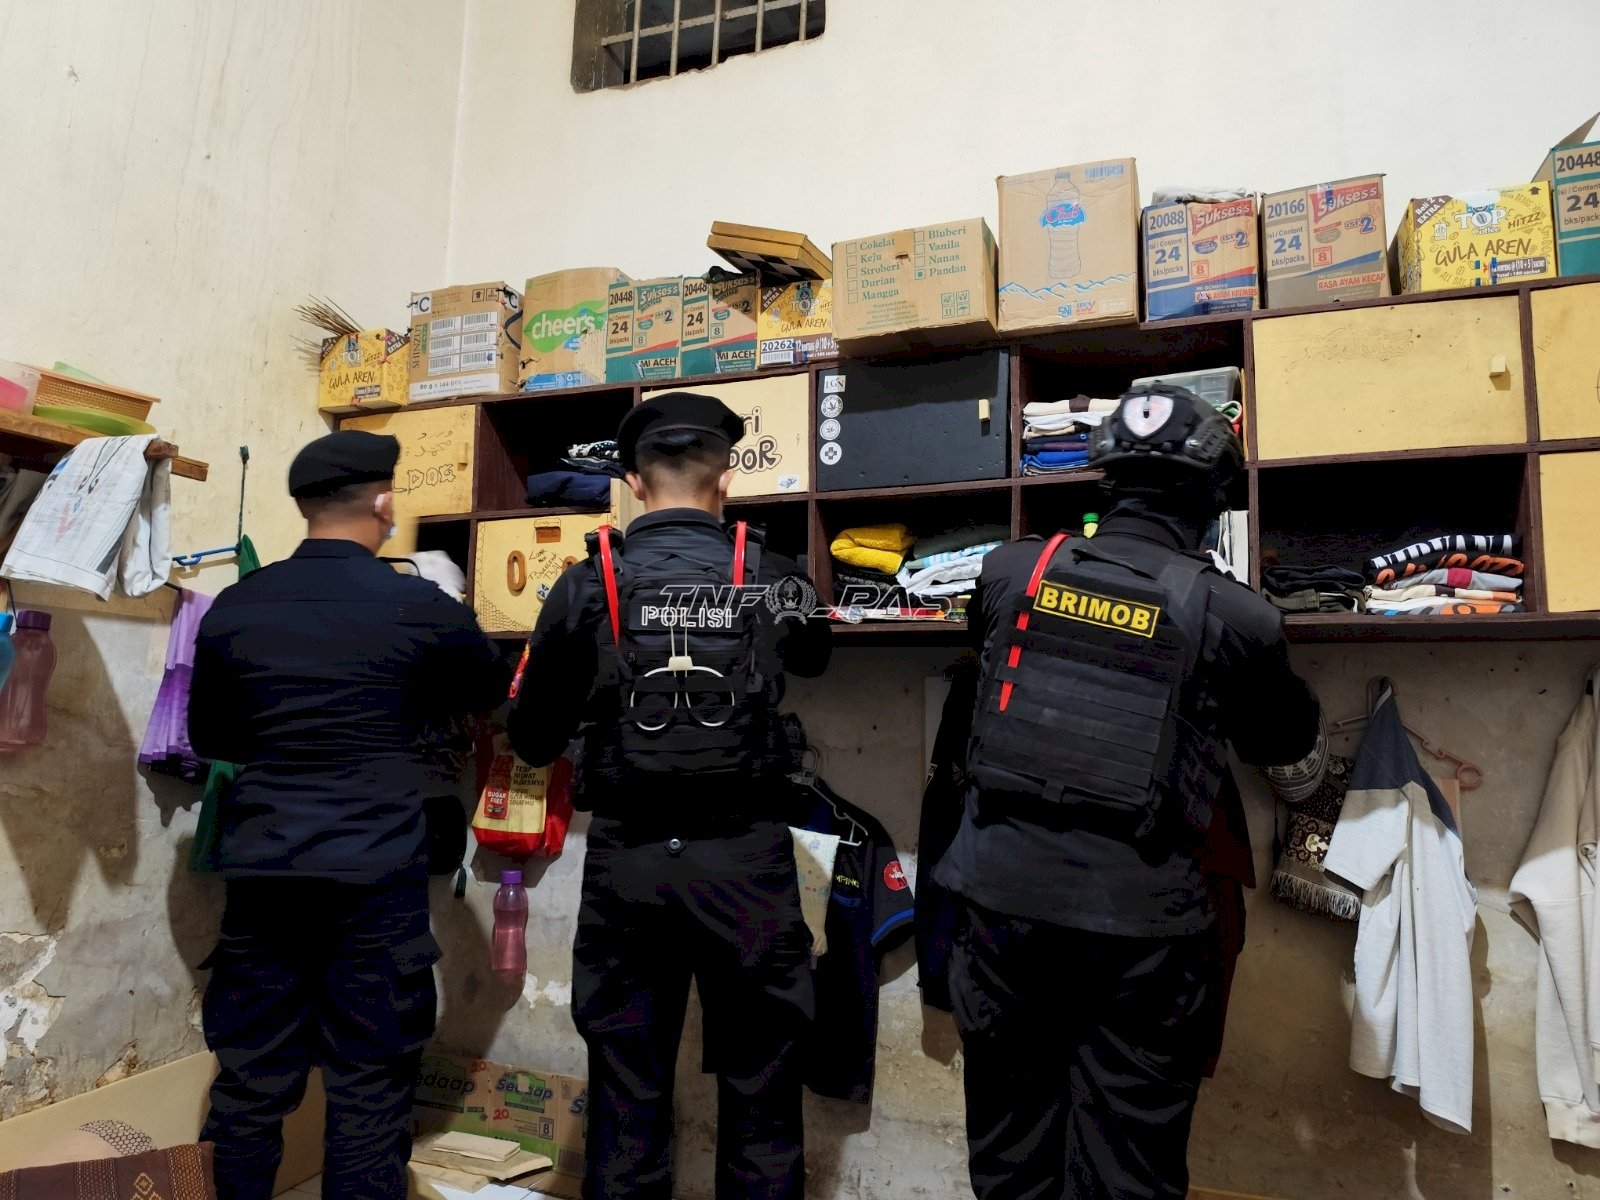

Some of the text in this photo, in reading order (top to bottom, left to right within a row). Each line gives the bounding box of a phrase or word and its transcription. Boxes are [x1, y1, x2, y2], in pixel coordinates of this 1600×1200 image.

[1267, 199, 1305, 219] 20166
[1415, 197, 1436, 216] Beli 2
[1566, 192, 1600, 213] 24
[1149, 210, 1185, 231] 20088
[1417, 204, 1442, 225] EXTRA
[1454, 208, 1508, 230] TOP
[1508, 211, 1542, 229] HITZZ
[1564, 213, 1600, 226] bks/pack
[1360, 216, 1374, 233] 2
[928, 226, 967, 240] Bluberi
[1234, 230, 1249, 248] 2
[859, 237, 896, 251] Cokelat
[928, 241, 961, 252] Vanila
[1273, 235, 1302, 254] 24
[860, 254, 882, 265] Keju
[929, 254, 960, 265] Nanas
[1154, 246, 1182, 265] 24
[1318, 253, 1327, 262] 8
[1435, 242, 1479, 267] GULA
[1484, 238, 1531, 257] AREN
[860, 262, 900, 277] Stroberi
[929, 265, 967, 277] Pandan
[1196, 265, 1205, 275] 8
[861, 277, 896, 289] Durian
[1318, 273, 1385, 289] RASA AYAM KECAP
[684, 282, 707, 297] 20448
[861, 288, 900, 301] Mangga
[419, 296, 430, 313] C
[609, 290, 633, 306] 20448
[763, 292, 780, 308] EXTRA
[789, 298, 820, 313] TOP
[741, 300, 751, 313] 2
[664, 309, 673, 322] 2
[687, 311, 704, 327] 24
[531, 313, 596, 341] cheers
[611, 321, 628, 335] 24
[714, 327, 720, 336] 8
[781, 318, 828, 333] GULA AREN
[762, 339, 793, 351] 20262
[341, 349, 364, 363] TOP
[653, 358, 677, 367] ACEH
[717, 350, 756, 360] MI ACEH
[329, 370, 376, 390] GULA AREN
[1040, 586, 1151, 631] BRIMOB
[641, 605, 733, 629] POLISI
[512, 779, 545, 787] MANISNYA
[487, 790, 507, 799] SUGAR
[471, 1060, 487, 1073] 20
[493, 1109, 510, 1121] 20
[543, 1124, 550, 1135] 8
